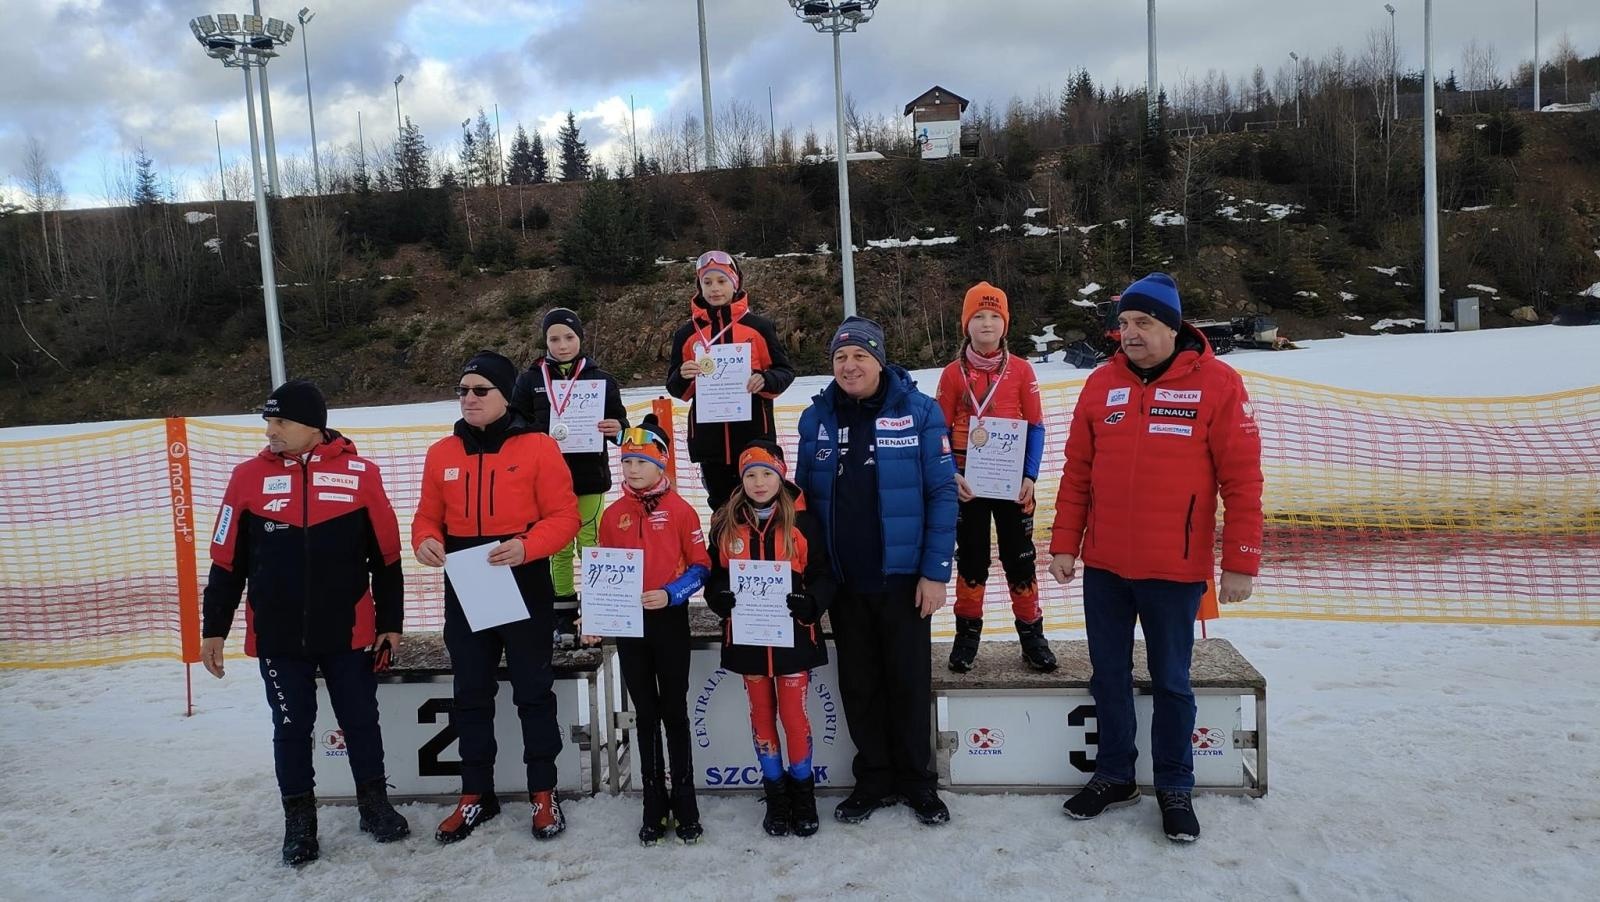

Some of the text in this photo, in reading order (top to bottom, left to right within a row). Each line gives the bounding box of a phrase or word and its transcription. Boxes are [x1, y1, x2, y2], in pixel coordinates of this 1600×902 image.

[1104, 411, 1126, 424] 4F
[1150, 408, 1197, 418] RENAULT
[890, 419, 911, 427] ORLEN
[878, 437, 917, 446] RENAULT
[816, 449, 832, 461] 4F
[330, 477, 354, 485] ORLEN
[171, 463, 193, 536] marabut
[263, 499, 291, 512] 4F
[219, 506, 232, 536] DAIKIN
[589, 563, 635, 573] DYPLOM
[737, 575, 784, 585] DYPLOM
[265, 658, 292, 725] POLSKA
[695, 668, 728, 748] CENTRALN
[815, 683, 837, 746] SPORTU
[417, 697, 463, 777] 2
[1067, 704, 1097, 773] 3
[705, 766, 829, 786] SZCK
